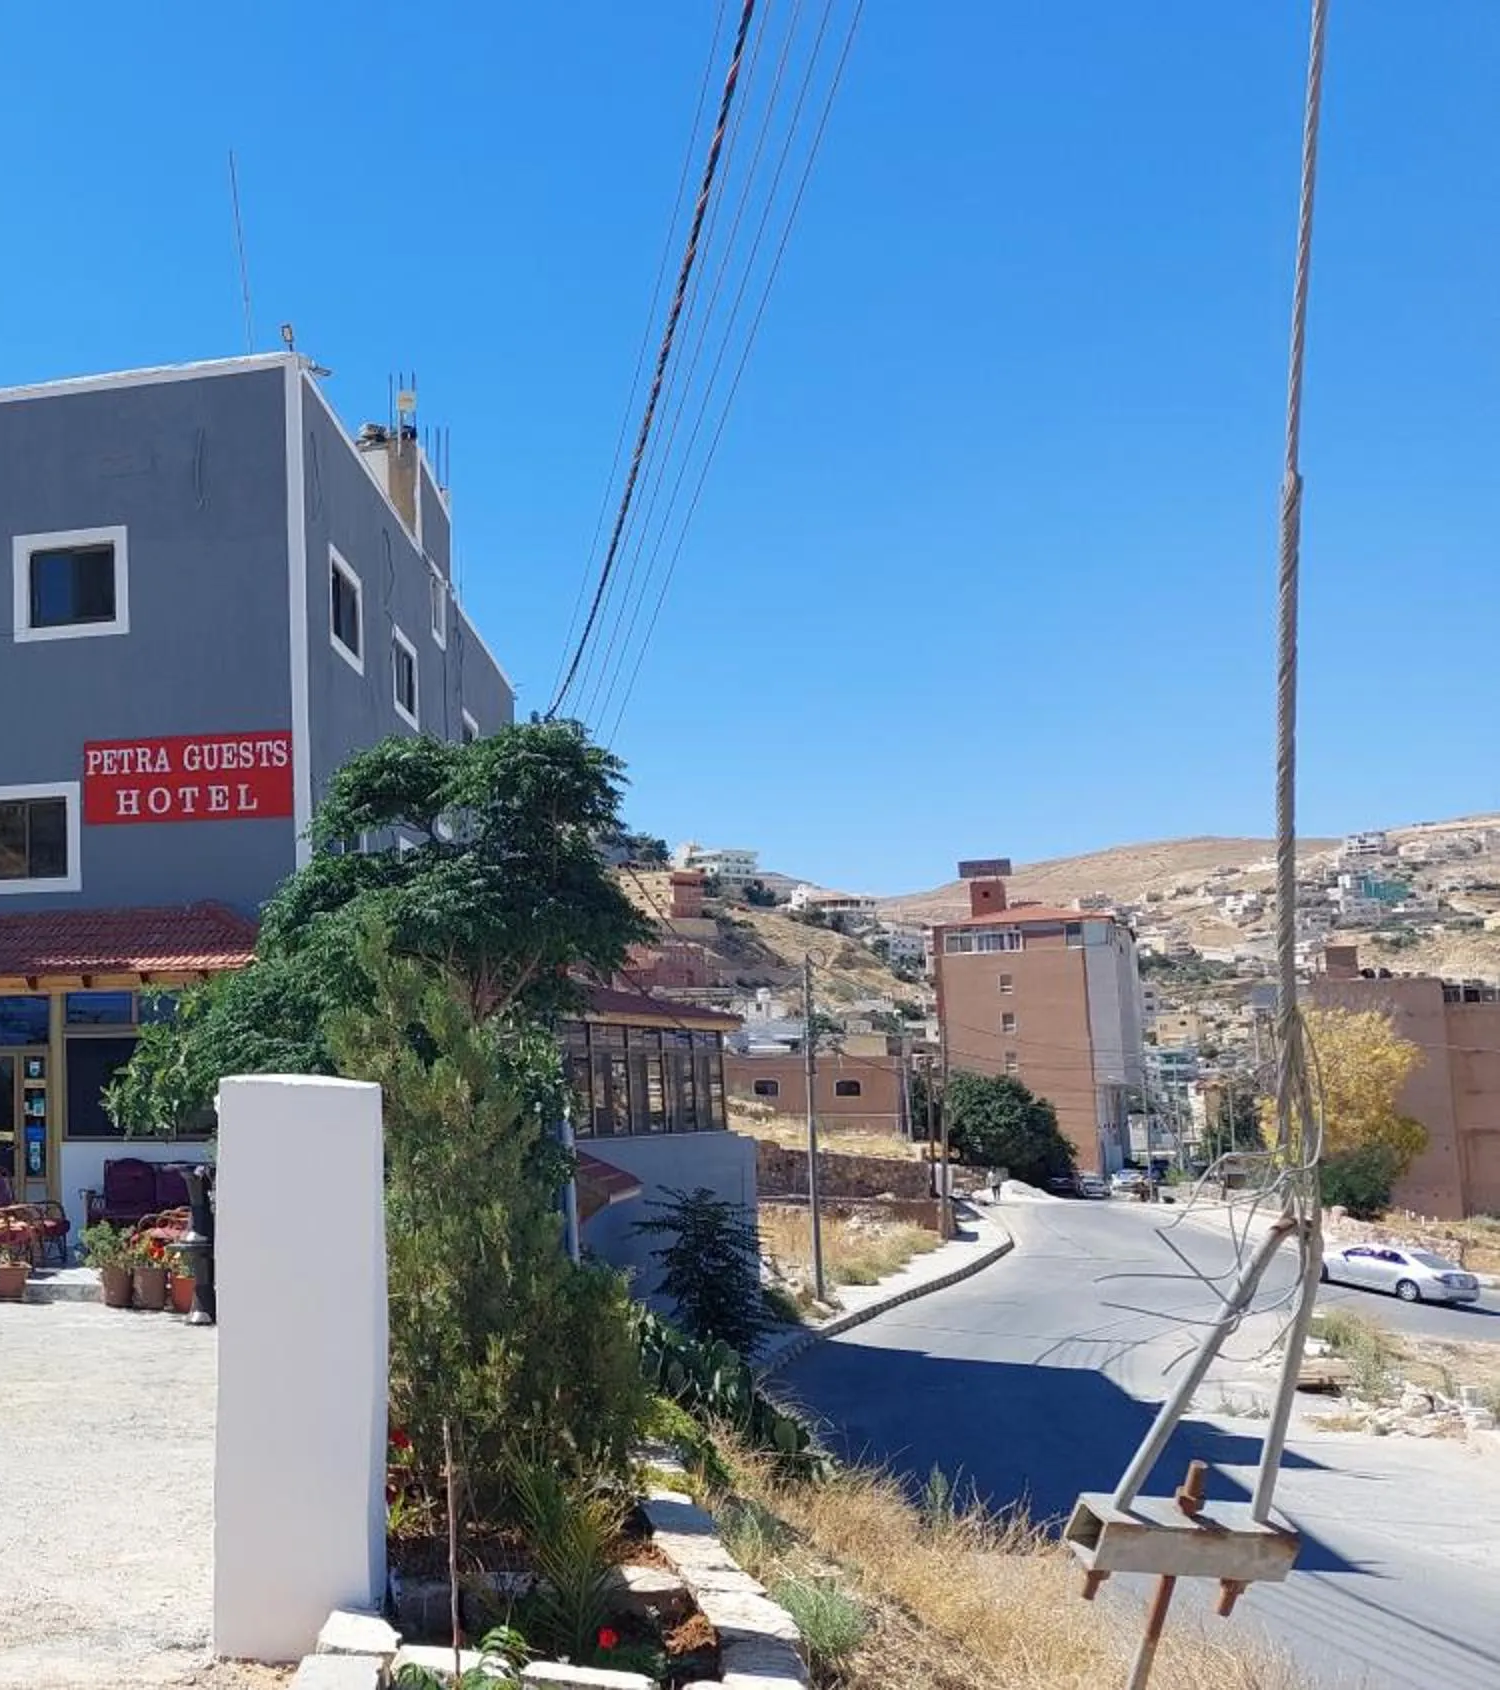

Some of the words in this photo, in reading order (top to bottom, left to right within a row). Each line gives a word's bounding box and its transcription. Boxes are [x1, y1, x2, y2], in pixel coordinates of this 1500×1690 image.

[87, 747, 171, 776] PETRA
[183, 740, 288, 771] GUESTS
[116, 784, 257, 815] HOTEL
